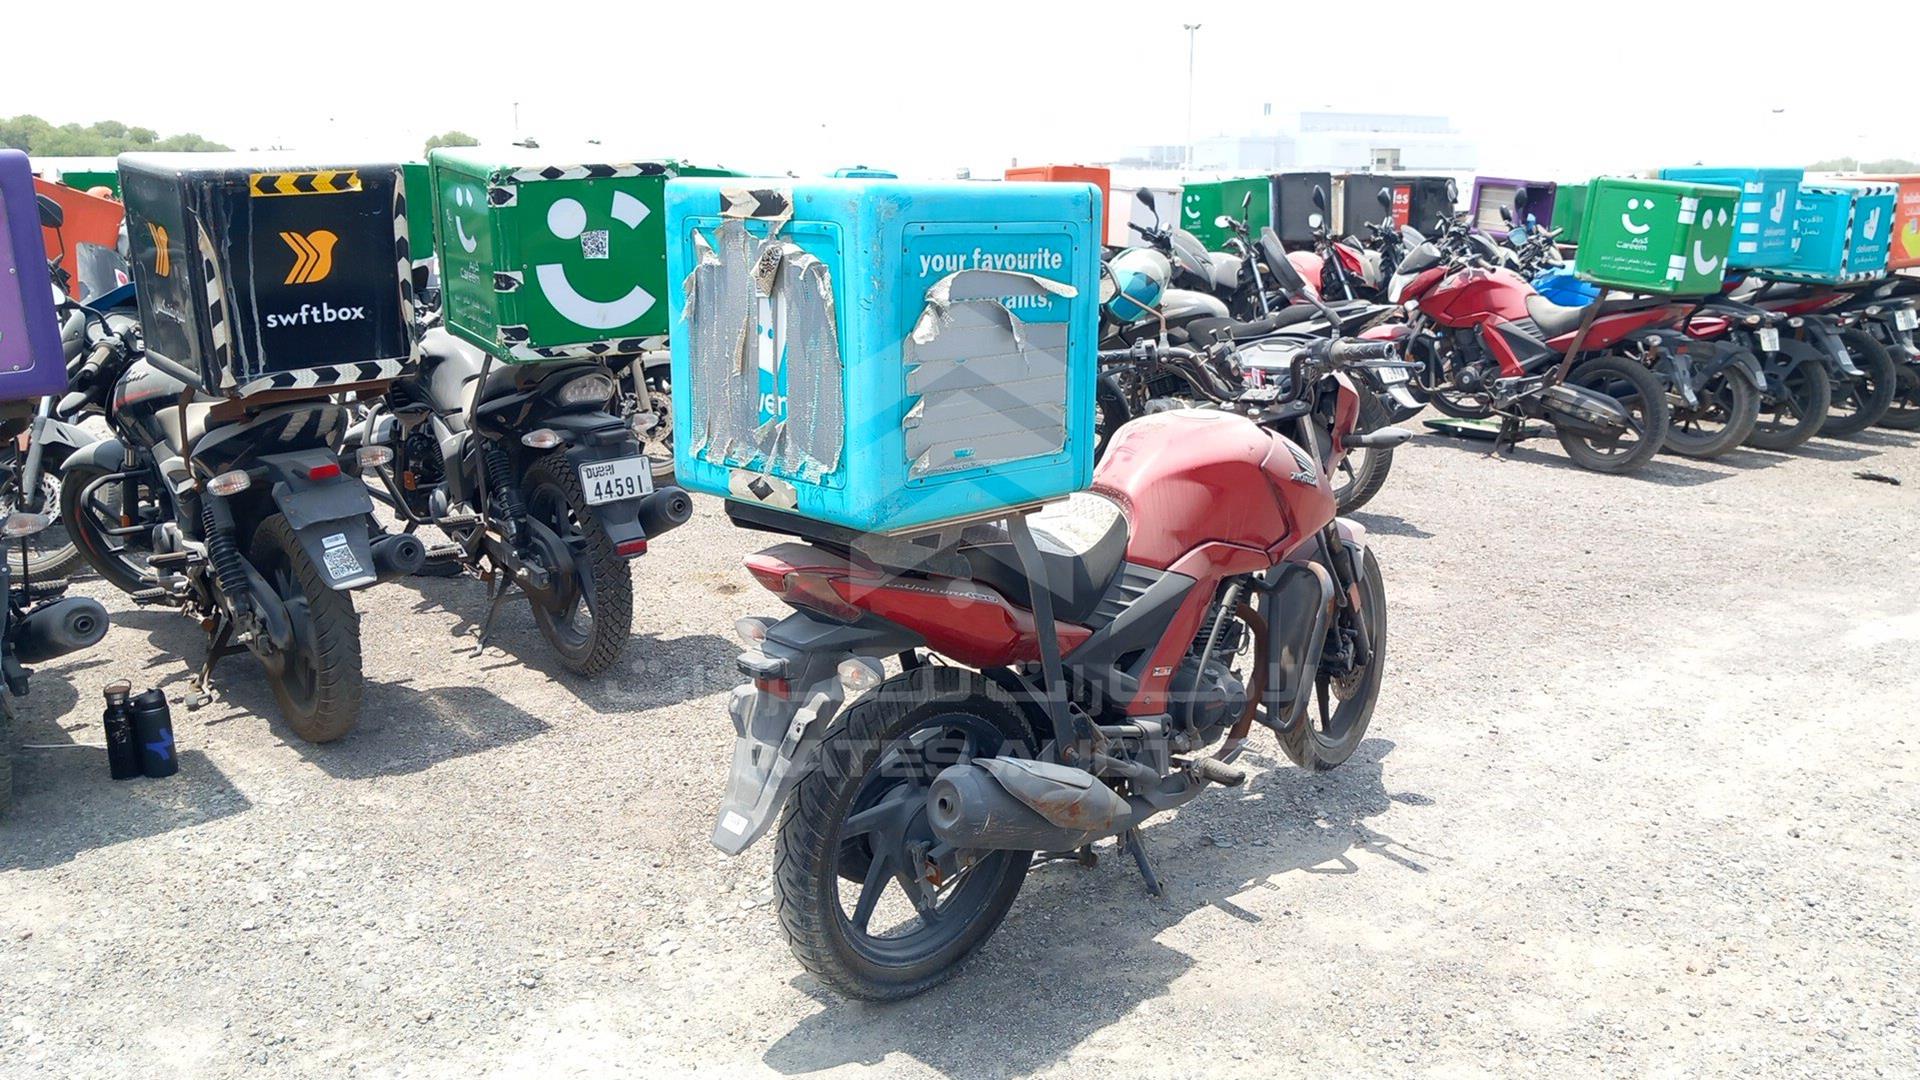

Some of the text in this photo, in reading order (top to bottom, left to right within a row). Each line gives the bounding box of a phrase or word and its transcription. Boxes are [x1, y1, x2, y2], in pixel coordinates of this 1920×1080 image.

[1616, 240, 1648, 251] Careem
[920, 248, 1063, 278] your favourite
[266, 303, 365, 328] swftbox
[594, 475, 643, 500] 44591
